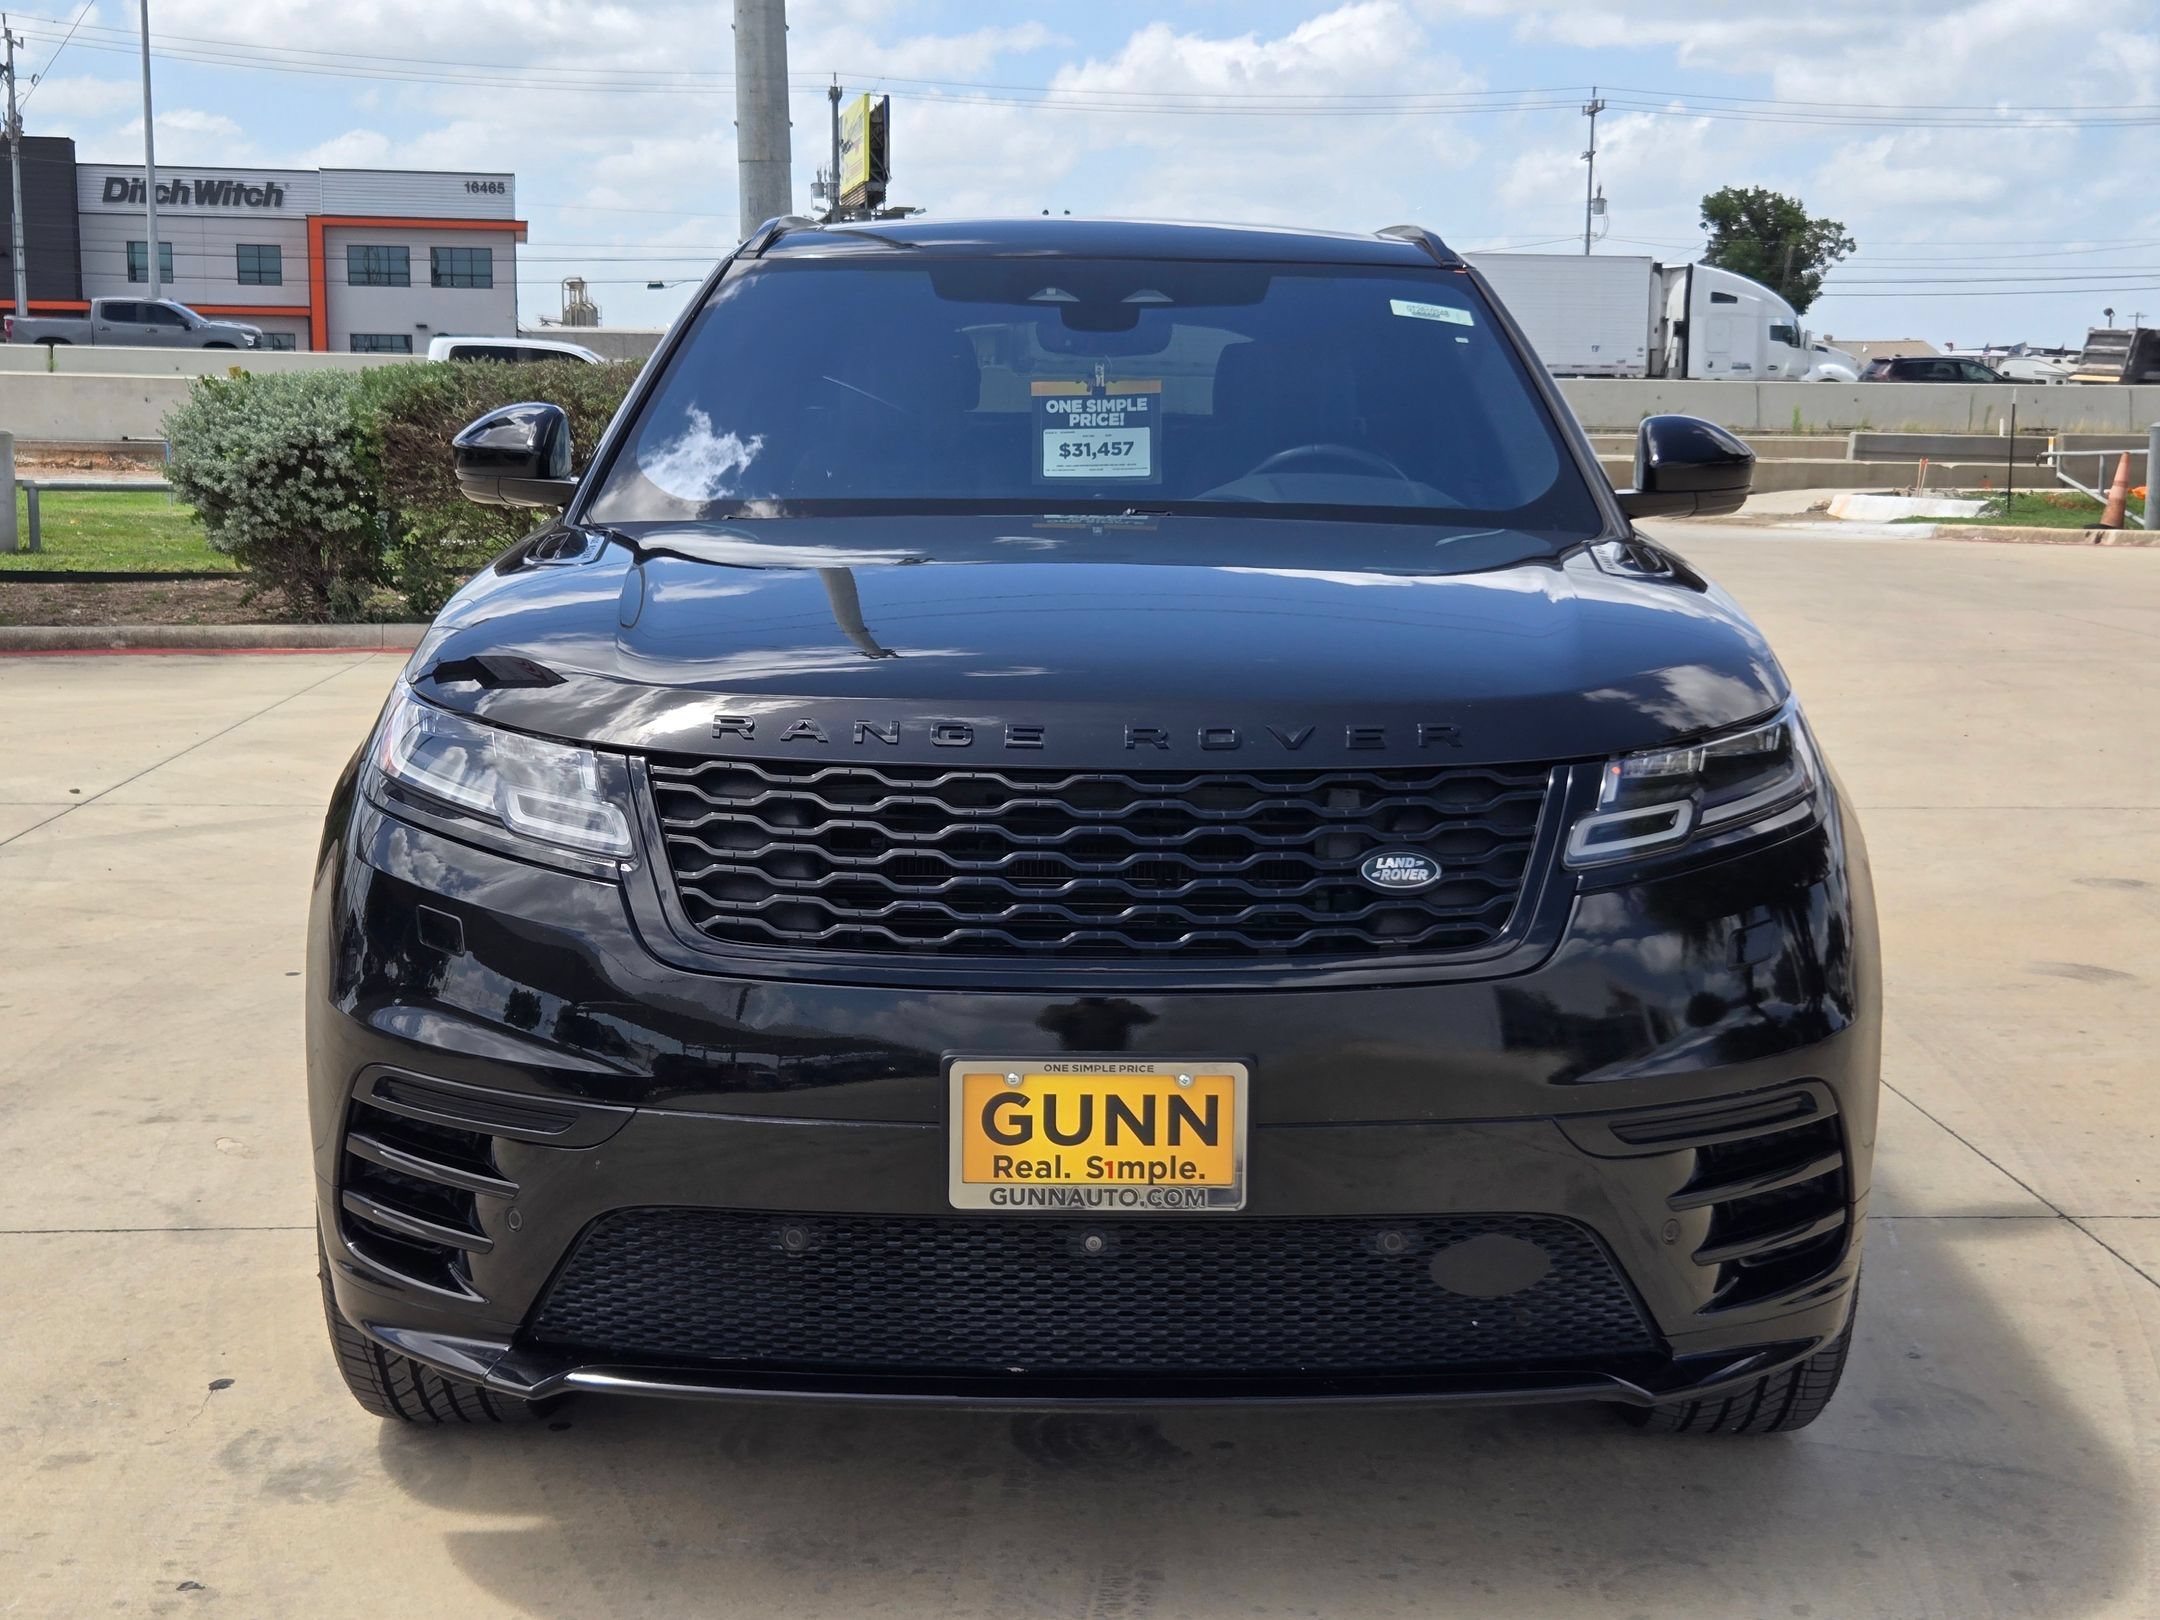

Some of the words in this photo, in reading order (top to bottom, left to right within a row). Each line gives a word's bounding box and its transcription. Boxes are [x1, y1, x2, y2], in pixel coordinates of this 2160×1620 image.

[102, 176, 190, 205] Ditch
[194, 179, 284, 208] Witch
[464, 181, 505, 194] 16465
[1045, 399, 1083, 413] ONE
[1086, 398, 1148, 412] SIMPLE
[1069, 412, 1125, 427] PRICE!
[1058, 441, 1135, 460] $31,457
[711, 714, 1045, 749] RANGE
[1124, 722, 1464, 750] ROVER
[1375, 857, 1416, 869] LAND
[1379, 868, 1429, 881] ROVER
[1043, 1064, 1070, 1073] ONE
[1072, 1064, 1116, 1073] SIMPLE
[1118, 1064, 1154, 1073] PRICE
[981, 1091, 1220, 1147] GUNN
[993, 1154, 1071, 1179] Real.
[989, 1187, 1208, 1209] GUNNAUTO.COM
